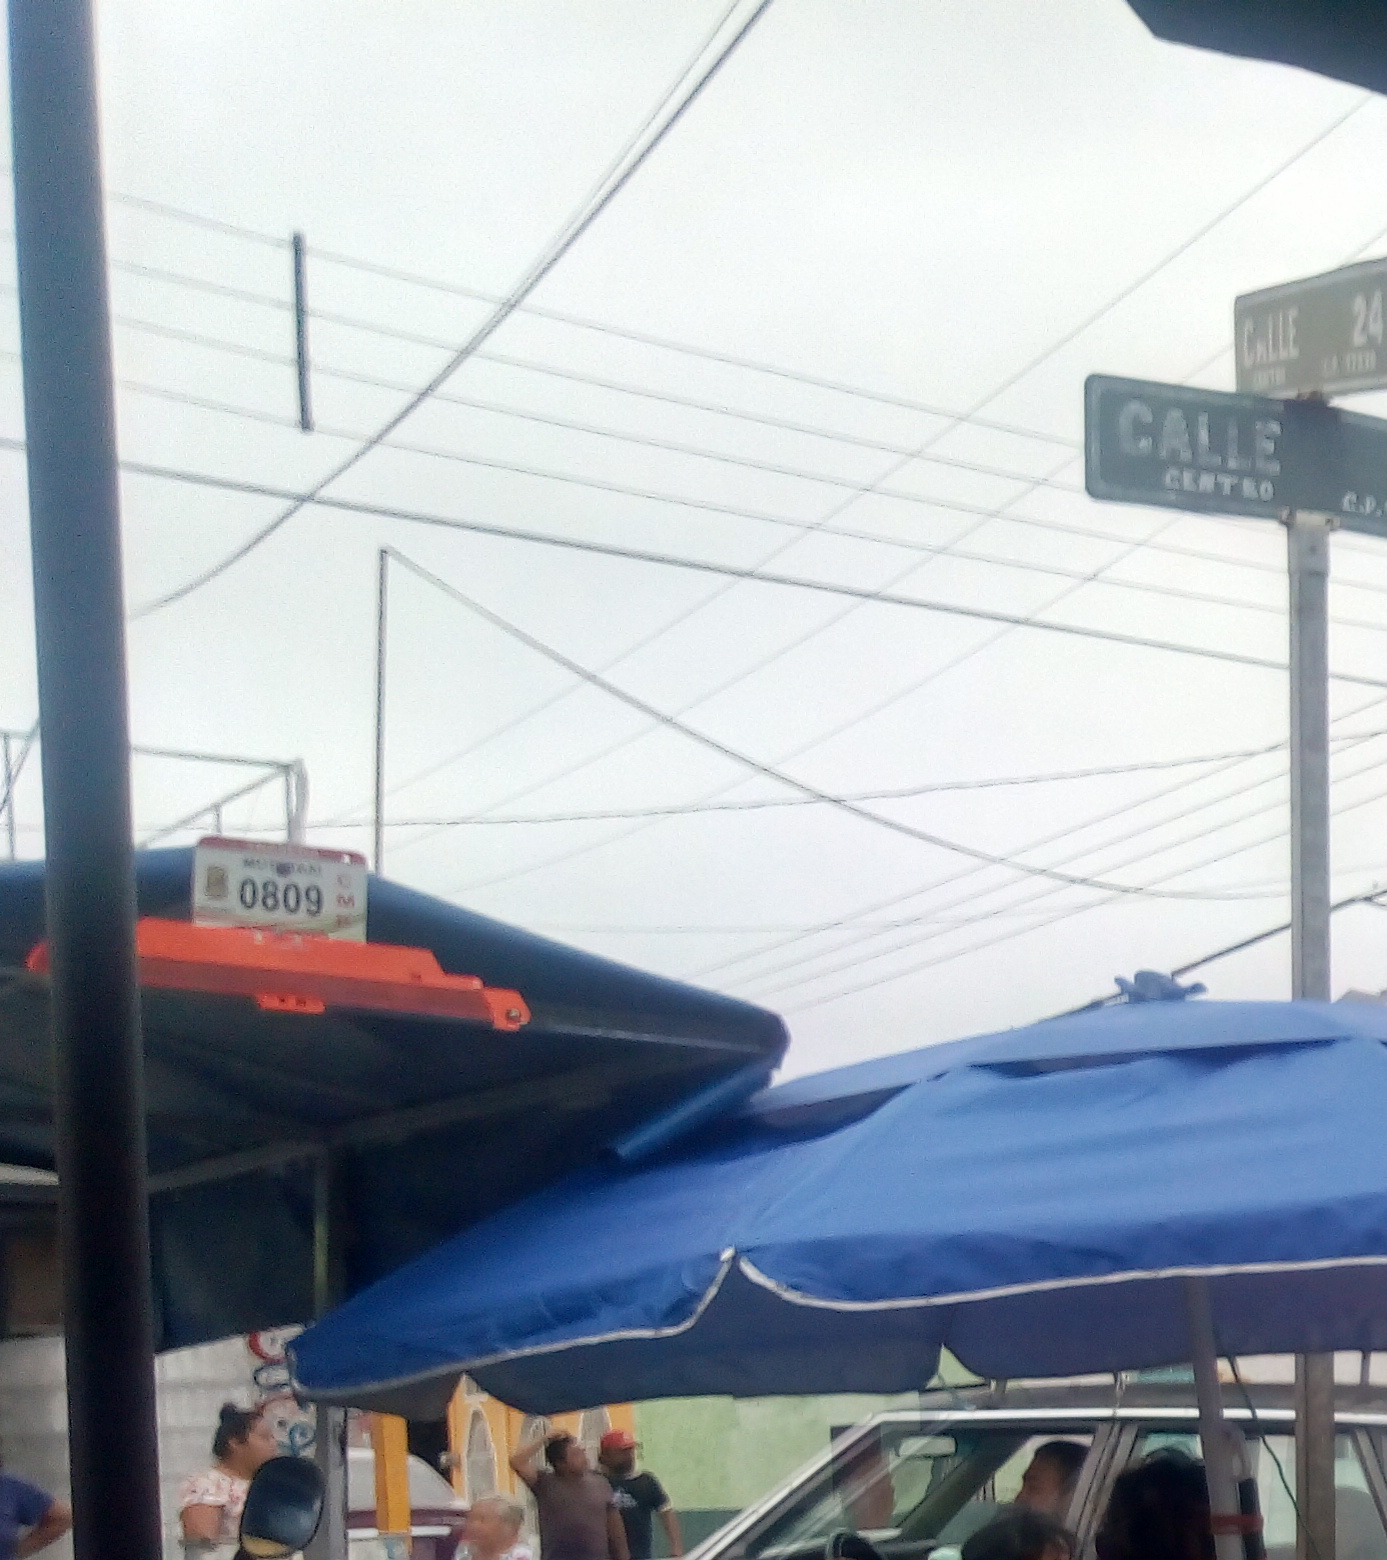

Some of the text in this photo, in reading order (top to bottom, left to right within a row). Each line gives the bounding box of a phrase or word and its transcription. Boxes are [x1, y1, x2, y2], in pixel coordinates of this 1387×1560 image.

[1242, 305, 1301, 367] CALLE
[1351, 289, 1385, 348] 24
[1117, 398, 1283, 478] CALLE
[239, 876, 323, 917] 0809
